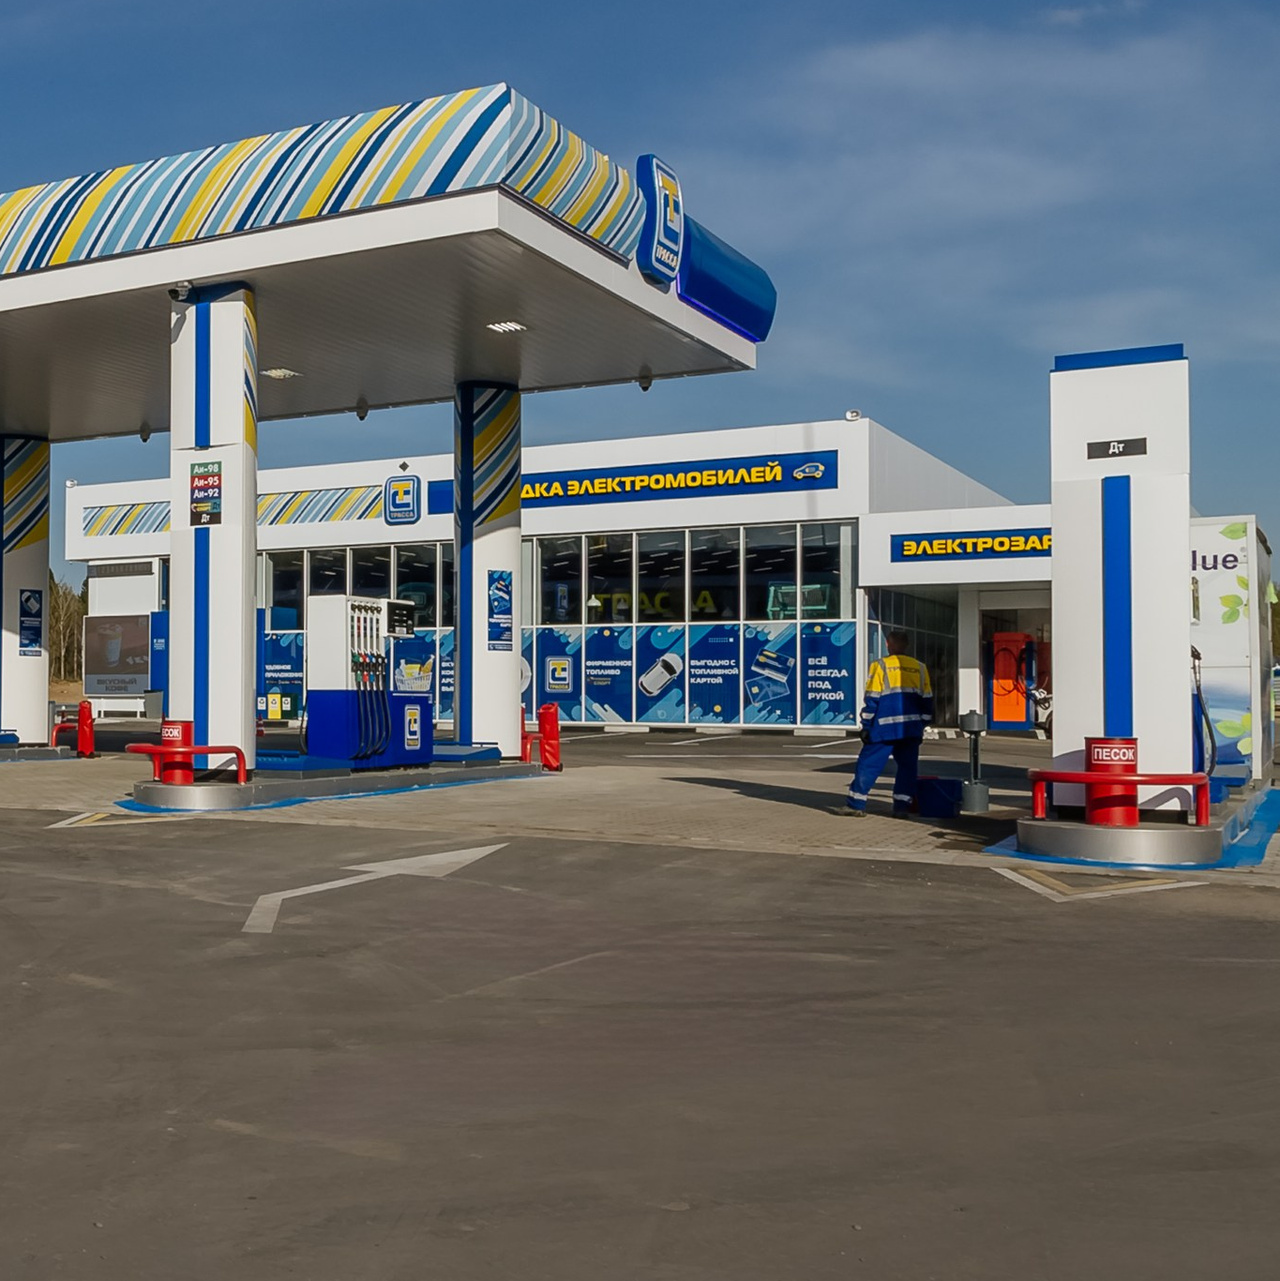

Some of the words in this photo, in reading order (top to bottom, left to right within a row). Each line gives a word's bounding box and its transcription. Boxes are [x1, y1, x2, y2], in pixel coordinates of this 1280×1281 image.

[656, 245, 678, 268] ТРАССА
[1108, 442, 1125, 455] Дт
[193, 463, 219, 474] Аи-98
[193, 476, 219, 487] Аи-95
[567, 461, 782, 496] ЭЛЕКТРОМОБИЛЕЙ
[193, 488, 219, 499] Аи-92
[690, 659, 730, 667] ВЫГОДНО
[808, 656, 828, 666] ВСЁ
[690, 667, 739, 676] ТОПЛИВНОЙ
[808, 669, 848, 678] ВСЕГДА
[690, 676, 723, 684] КАРТОЙ
[808, 681, 832, 689] ПОД
[808, 692, 845, 701] РУКОЙ
[1094, 748, 1135, 760] ПЕСОК
